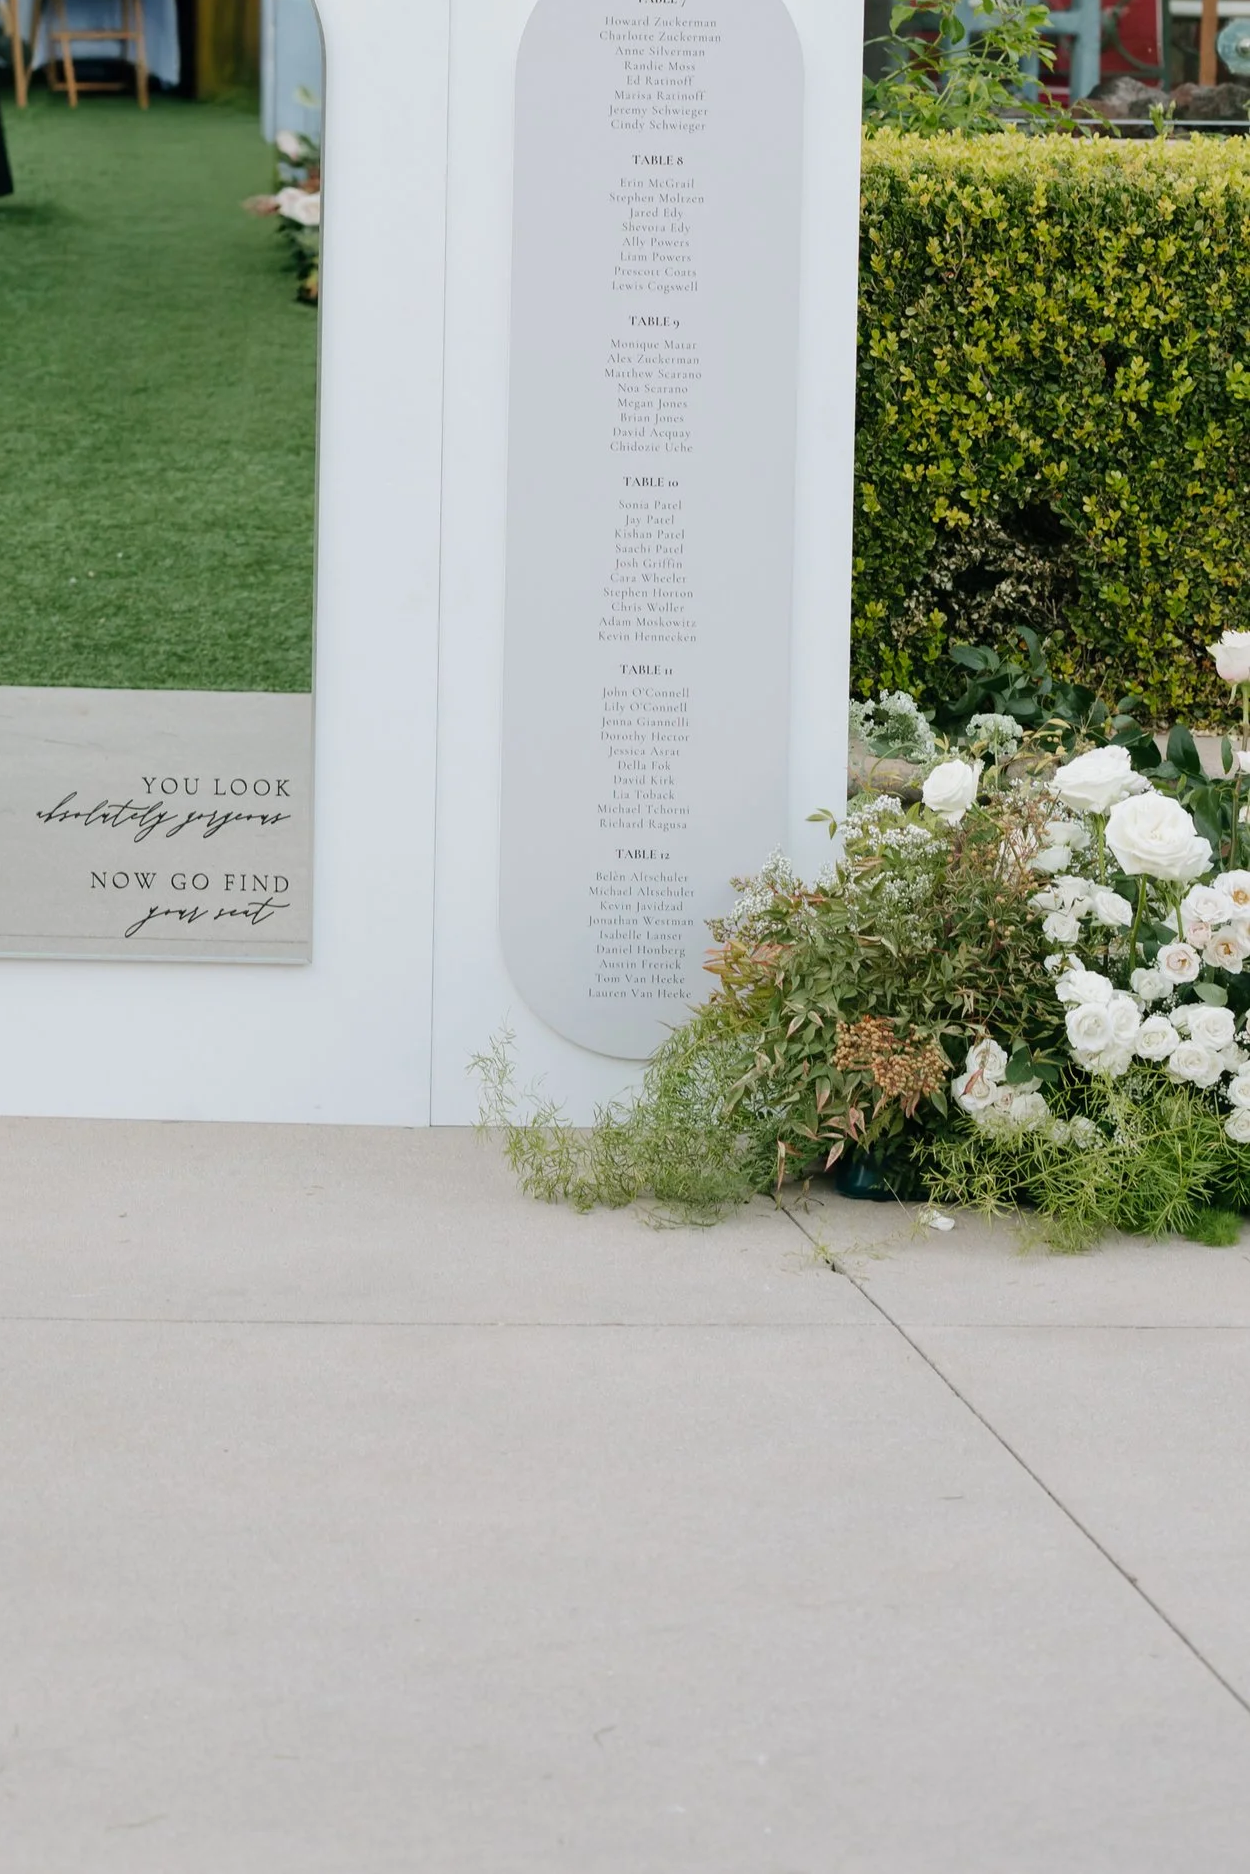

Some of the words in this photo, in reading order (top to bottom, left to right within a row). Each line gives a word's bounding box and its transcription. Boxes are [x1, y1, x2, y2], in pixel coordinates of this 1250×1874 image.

[604, 15, 650, 25] Howard
[654, 16, 717, 27] Zuckerman
[599, 30, 655, 41] Charlotte
[658, 31, 722, 42] Zuckerman
[614, 44, 645, 54] Anne
[648, 45, 706, 56] Silverman
[624, 59, 664, 70] Randie
[668, 60, 696, 71] Moss
[610, 118, 646, 131] Cindy
[632, 155, 673, 166] TABLE
[608, 191, 654, 205] Stephen
[629, 206, 659, 219] Jared
[622, 235, 646, 248] Ally
[650, 236, 690, 246] Powers
[620, 250, 648, 260] Liam
[652, 251, 694, 261] Powers
[612, 280, 644, 290] Lewis
[629, 316, 670, 326] TABLE
[610, 338, 660, 352] Monique
[606, 353, 633, 363] Alex
[636, 353, 700, 365] Zuckerman
[604, 367, 654, 378] Matthew
[617, 397, 654, 411] Megan
[657, 398, 688, 410] Jones
[620, 411, 650, 421] Brian
[654, 412, 686, 424] Jones
[623, 477, 664, 487] TABLE
[657, 529, 685, 539] Patel
[614, 557, 639, 569] Josh
[642, 558, 683, 568] Griffin
[609, 572, 637, 582] Cara
[641, 573, 686, 583] Wheeler
[611, 601, 642, 611] Chris
[598, 616, 632, 626] Adam
[636, 616, 698, 628] Moskowitz
[620, 665, 661, 675] TABLE
[601, 687, 628, 699] John
[604, 701, 626, 714] Lily
[617, 759, 647, 769] Della
[613, 774, 646, 784] David
[650, 775, 678, 785] Kirk
[141, 776, 200, 796] YOU
[213, 777, 291, 797] LOOK
[36, 791, 179, 843] absolutely
[165, 809, 291, 839] gorgeous
[615, 850, 656, 860] TABLE
[91, 871, 157, 890] NOW
[170, 872, 210, 892] GO
[224, 873, 290, 893] FIND
[588, 884, 632, 895] Michael
[124, 903, 209, 938] your
[214, 897, 291, 925] seat
[588, 913, 638, 926] Jonathan
[596, 943, 633, 953] Daniel
